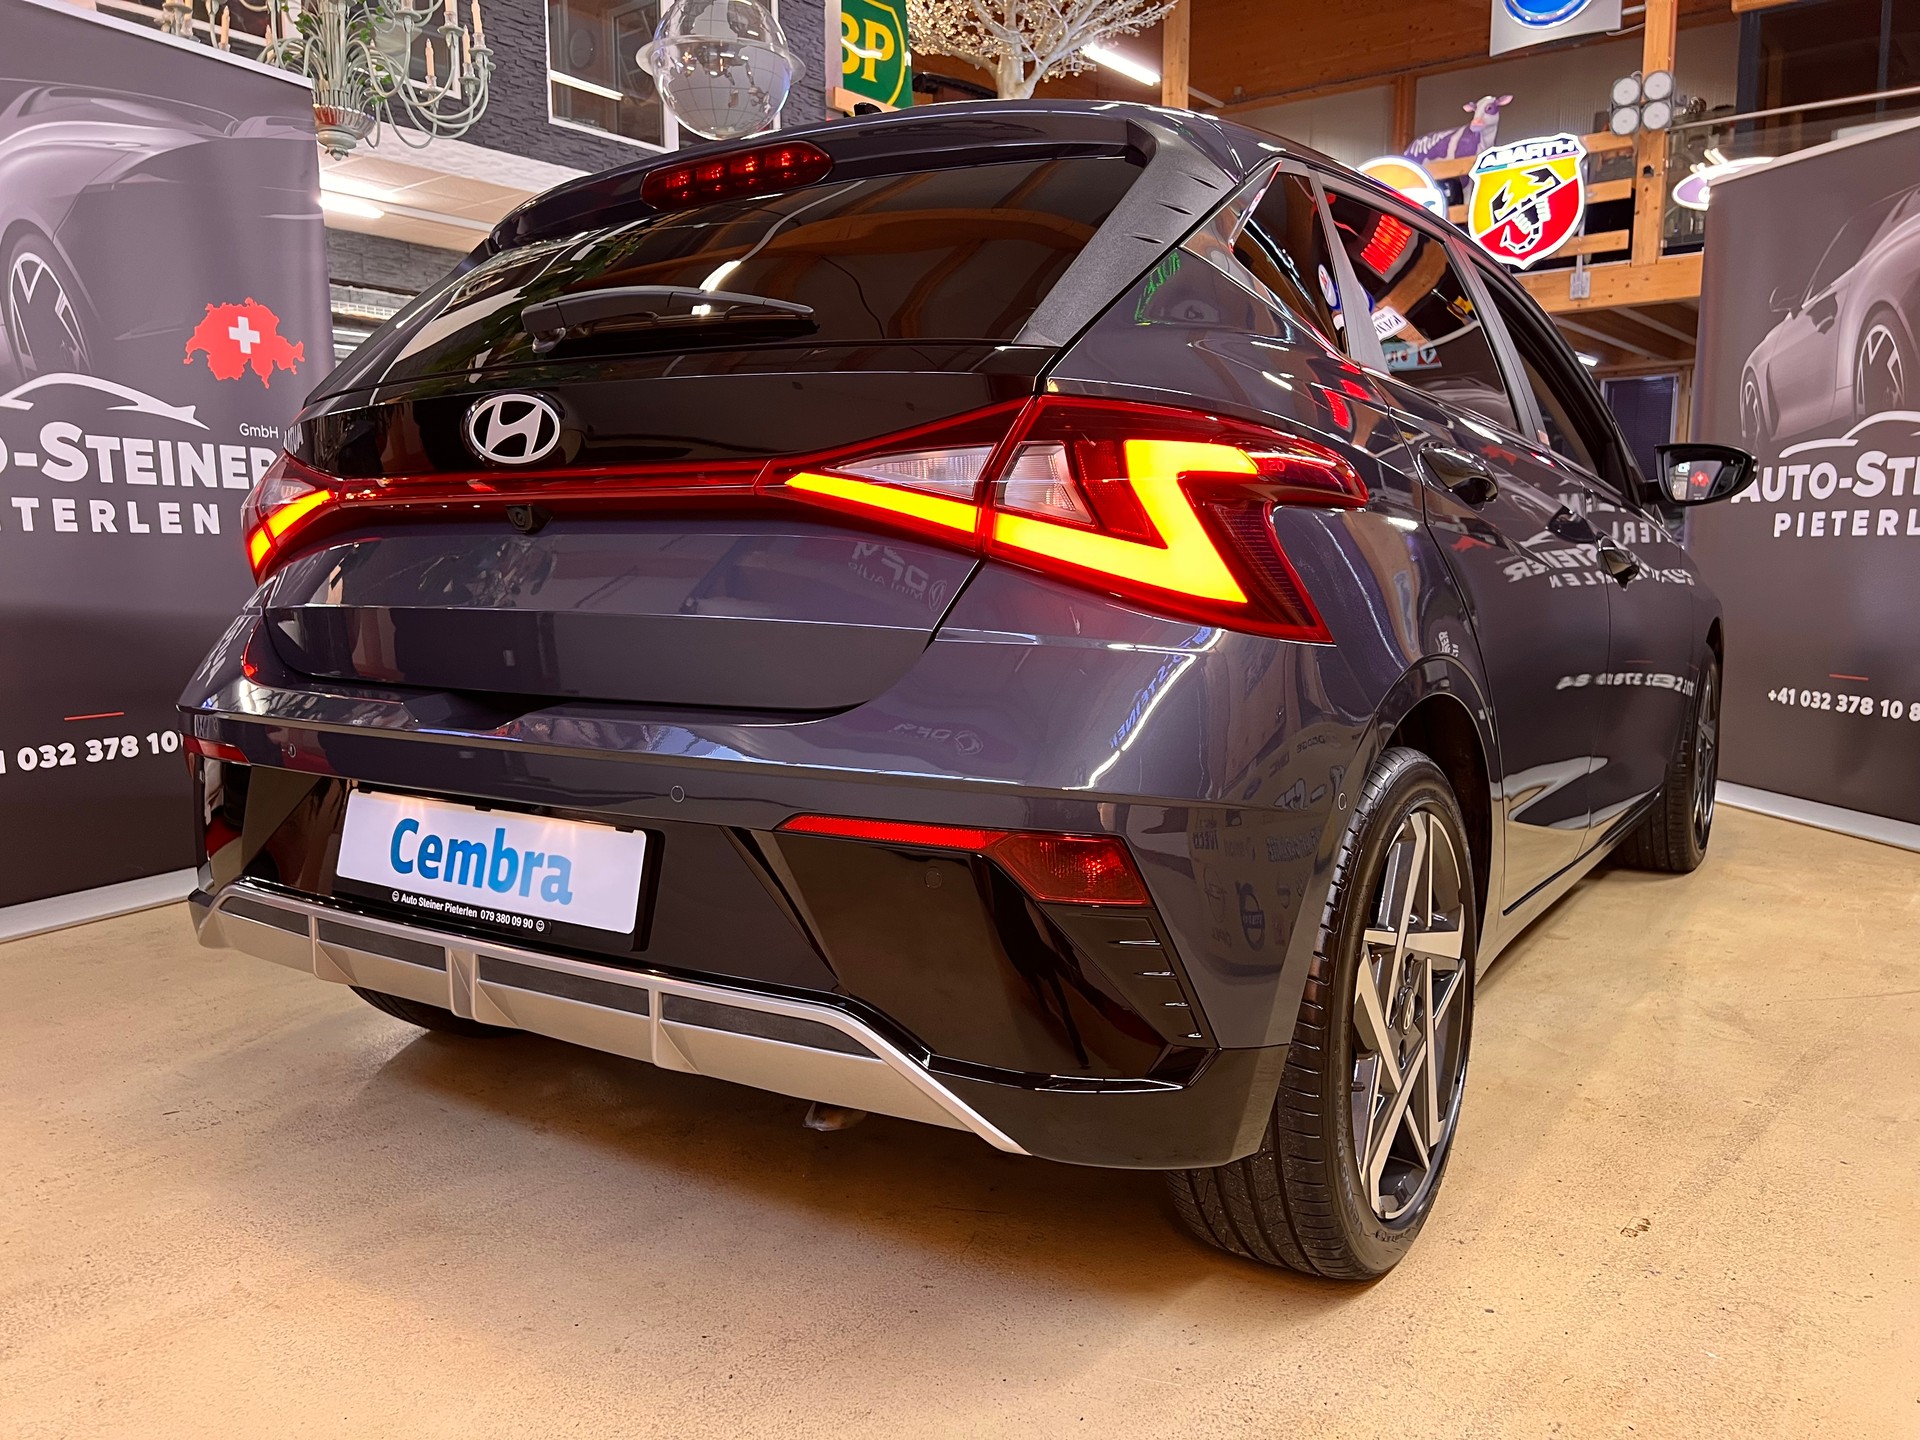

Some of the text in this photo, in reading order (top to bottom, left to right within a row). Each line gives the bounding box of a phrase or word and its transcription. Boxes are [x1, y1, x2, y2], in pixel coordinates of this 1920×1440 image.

[1477, 138, 1579, 169] ABARTH
[239, 423, 279, 439] GmbH
[0, 421, 278, 490] -STEINER
[1730, 450, 1920, 504] UTO-ST
[0, 497, 220, 534] TERLEN
[1773, 508, 1920, 538] PIETERL
[1768, 687, 1796, 706] +41
[1800, 690, 1832, 711] 032
[1835, 694, 1874, 716] 378
[1880, 699, 1904, 720] 10
[17, 742, 77, 772] 032
[85, 735, 139, 763] 378
[146, 730, 178, 755] 10
[390, 818, 573, 905] Cembra
[401, 893, 534, 929] Auto Steiner Pieterlen 079 380 09 90
